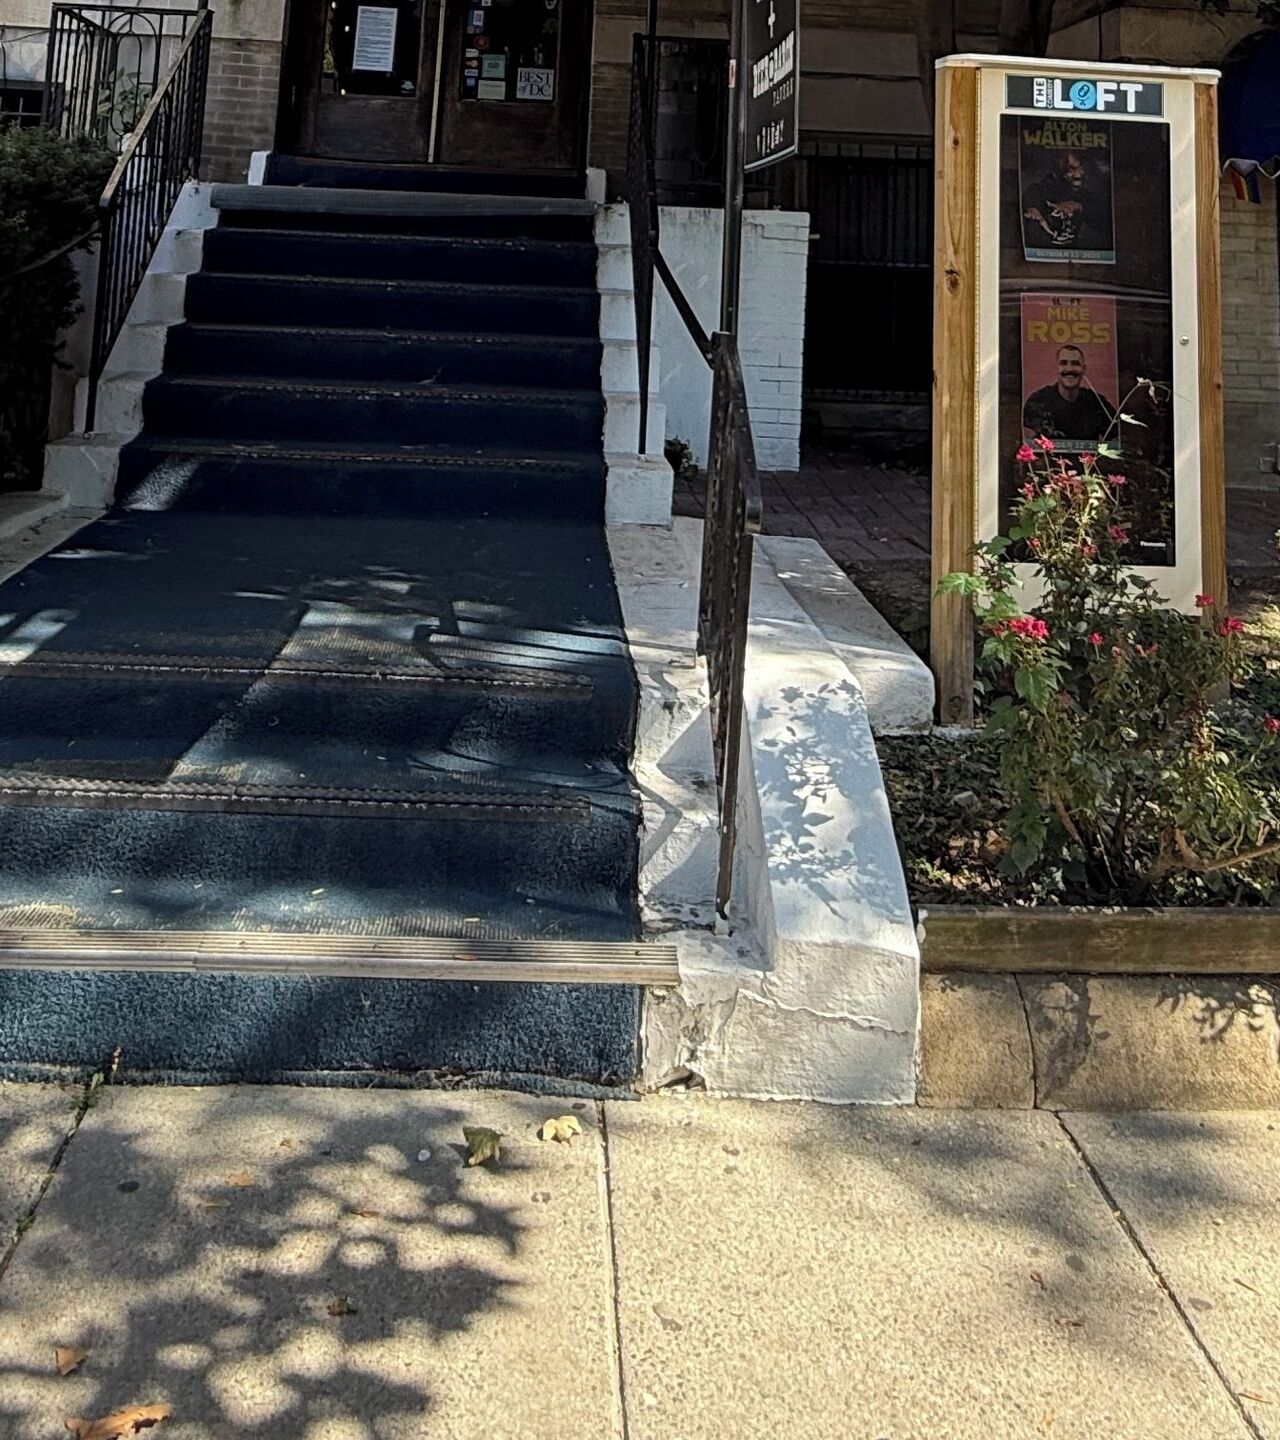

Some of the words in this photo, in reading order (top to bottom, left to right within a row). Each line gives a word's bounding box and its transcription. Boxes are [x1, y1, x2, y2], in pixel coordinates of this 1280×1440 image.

[519, 71, 551, 84] BEST
[529, 84, 551, 97] DC
[1034, 79, 1045, 105] THE
[1054, 79, 1143, 112] LOFT
[1043, 120, 1087, 131] ALTON
[1023, 129, 1107, 148] WALKER
[1047, 306, 1090, 320] MIKE
[1027, 320, 1112, 344] ROSS
